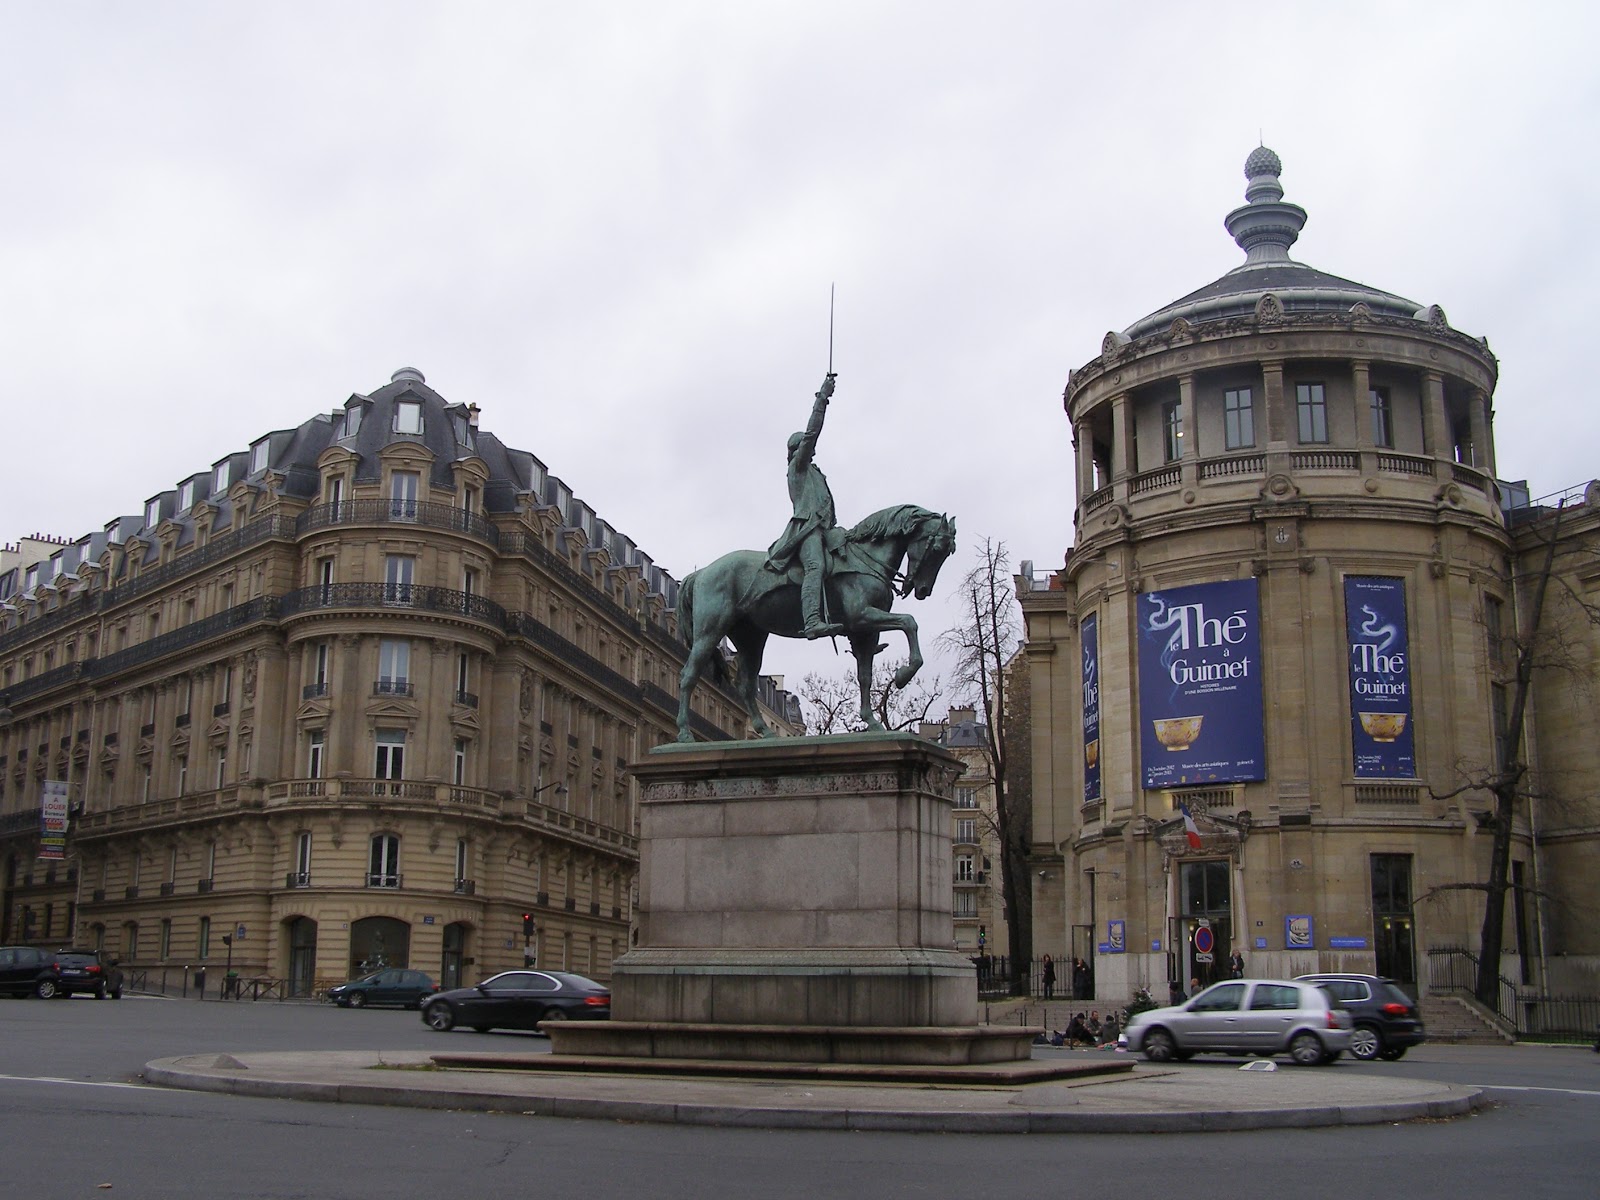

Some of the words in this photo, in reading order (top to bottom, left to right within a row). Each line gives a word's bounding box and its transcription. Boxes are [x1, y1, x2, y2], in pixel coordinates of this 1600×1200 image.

[1168, 603, 1247, 650] Thé
[1170, 639, 1179, 652] le
[1353, 644, 1404, 674] Thé
[1170, 656, 1251, 685] Guimet
[1354, 677, 1406, 695] Guimet
